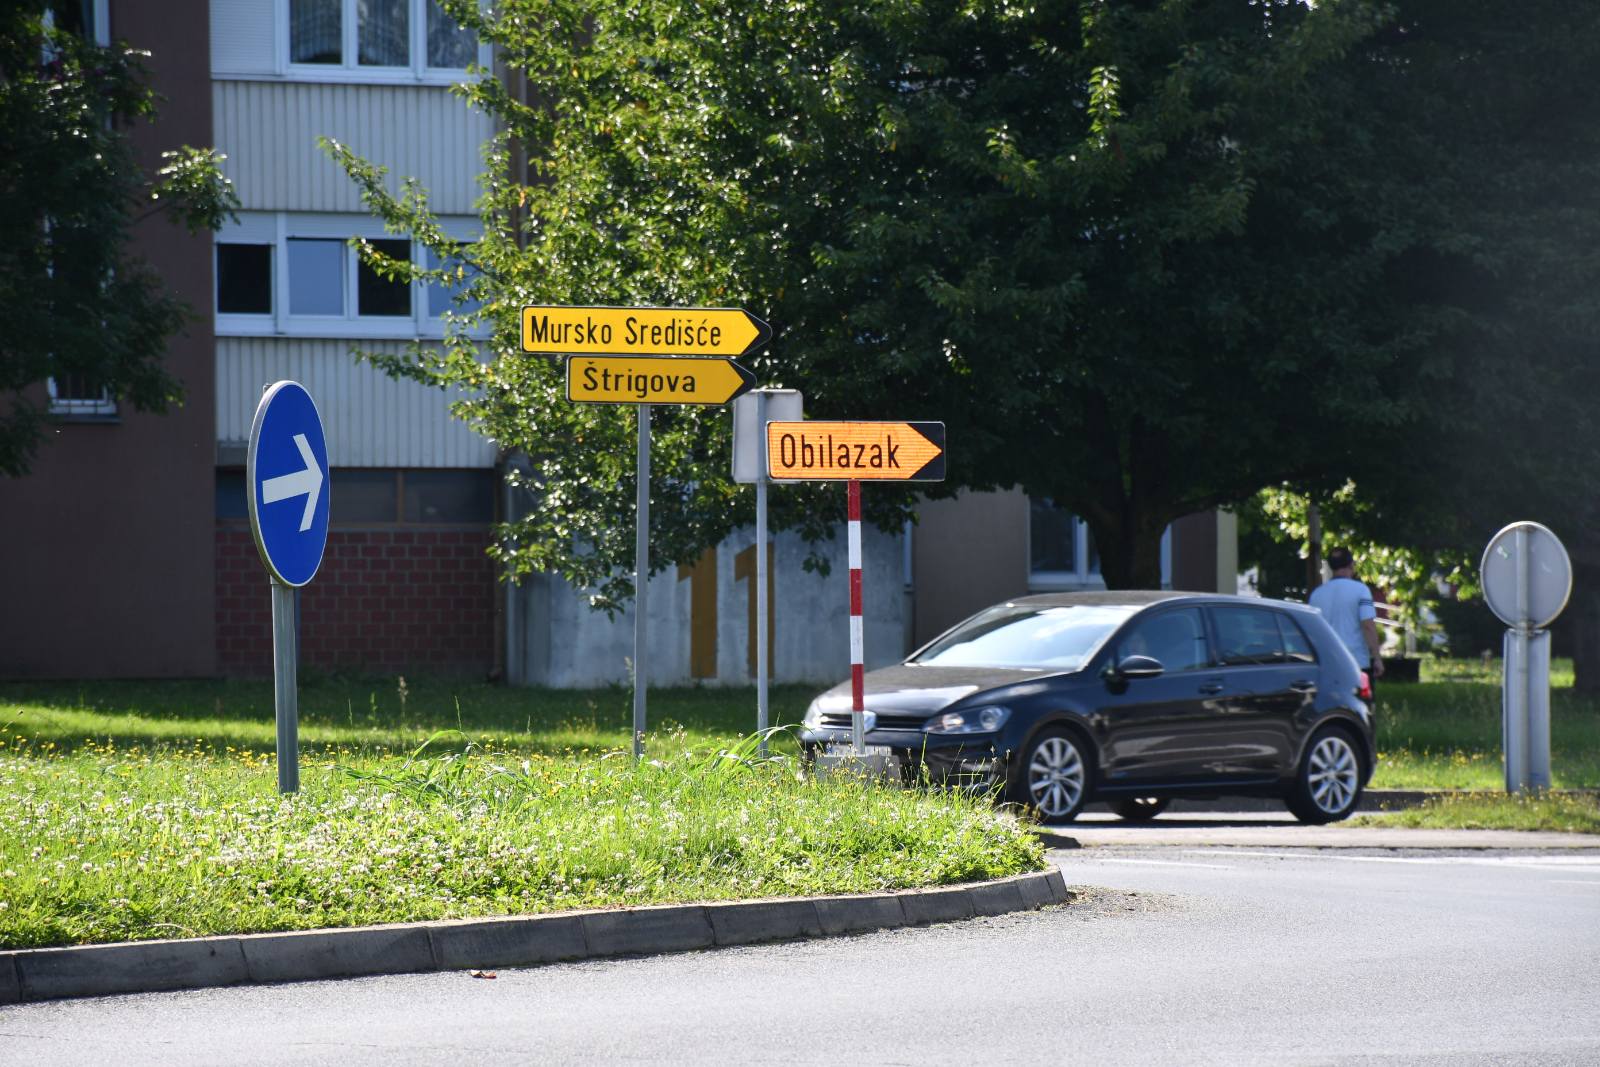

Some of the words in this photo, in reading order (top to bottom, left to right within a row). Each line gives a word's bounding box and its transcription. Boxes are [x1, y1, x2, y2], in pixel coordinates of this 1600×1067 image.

[531, 315, 612, 346] Mursko
[625, 316, 721, 347] Središće
[583, 361, 696, 398] Štrigova
[780, 433, 900, 469] Obilazak
